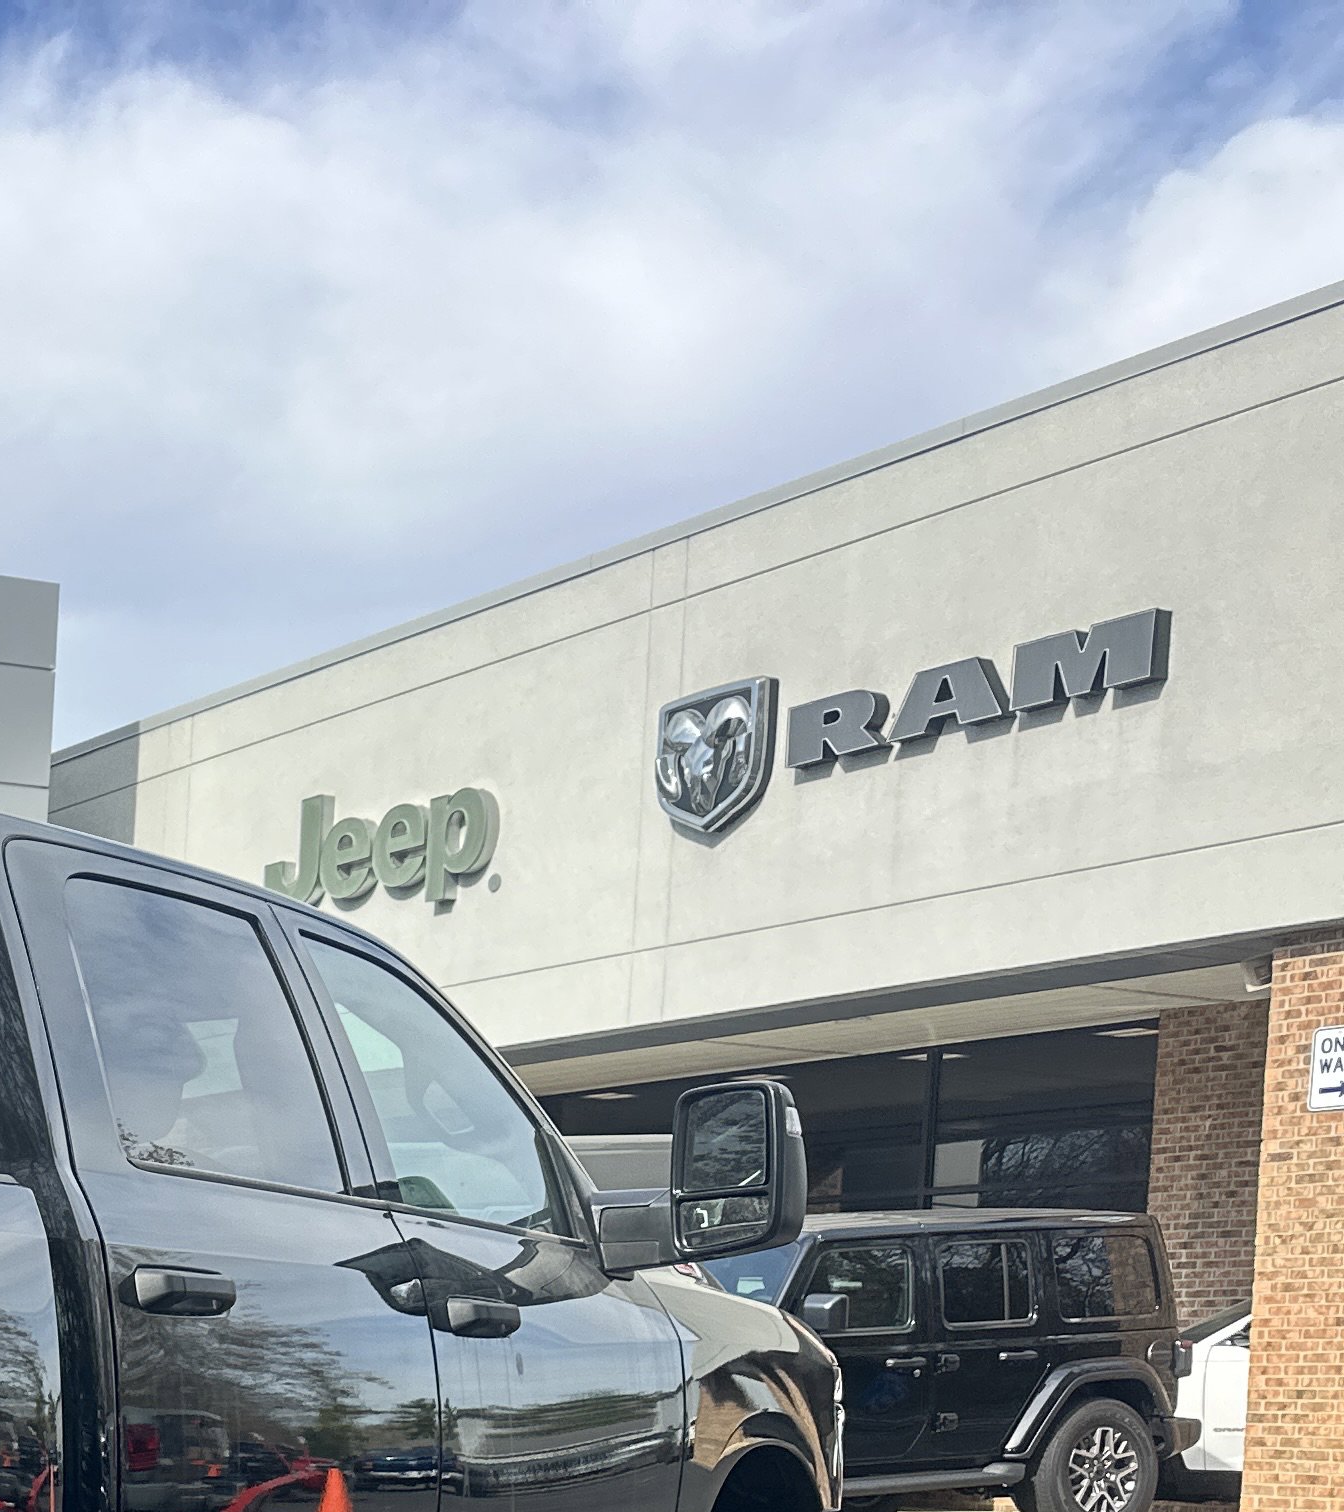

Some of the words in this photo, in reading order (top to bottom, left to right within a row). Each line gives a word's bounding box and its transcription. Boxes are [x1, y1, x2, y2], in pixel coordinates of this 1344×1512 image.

[785, 608, 1172, 768] RAM
[1321, 1036, 1344, 1054] ON
[1320, 1057, 1344, 1074] WA
